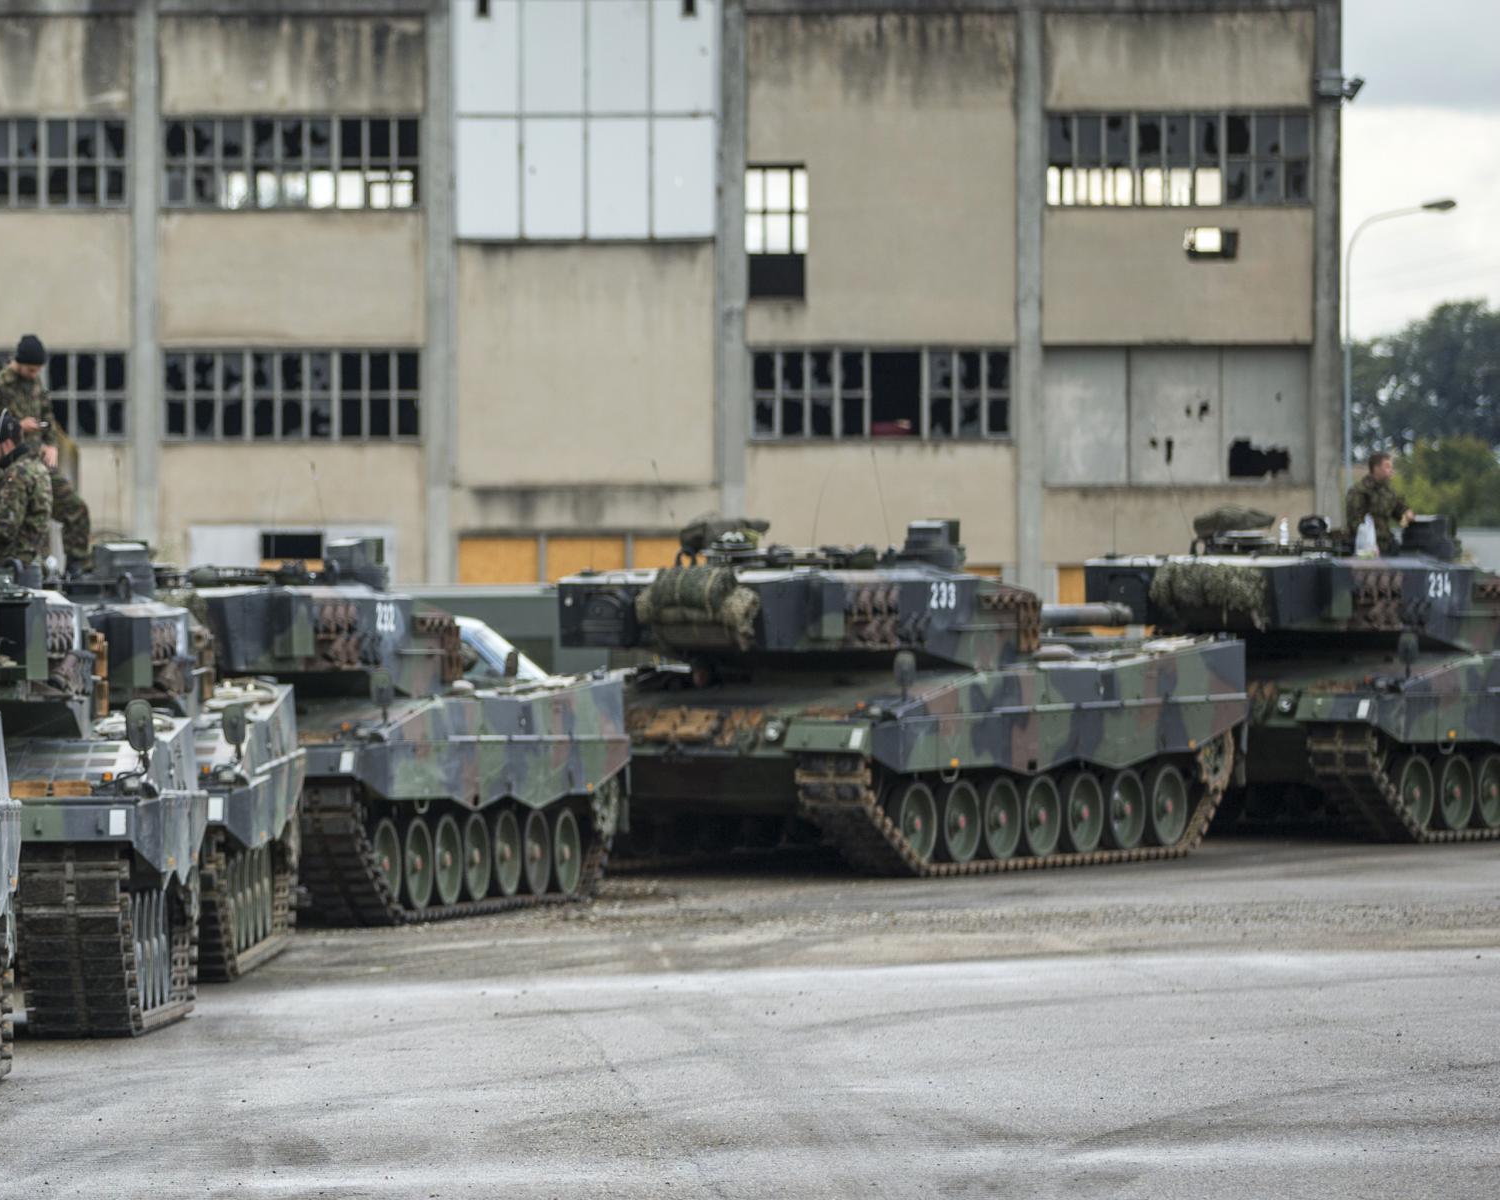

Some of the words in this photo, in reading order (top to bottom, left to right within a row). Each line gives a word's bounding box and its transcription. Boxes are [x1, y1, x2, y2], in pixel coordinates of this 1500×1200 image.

[930, 582, 956, 609] 233
[1429, 572, 1451, 598] 234
[376, 602, 396, 632] 232
